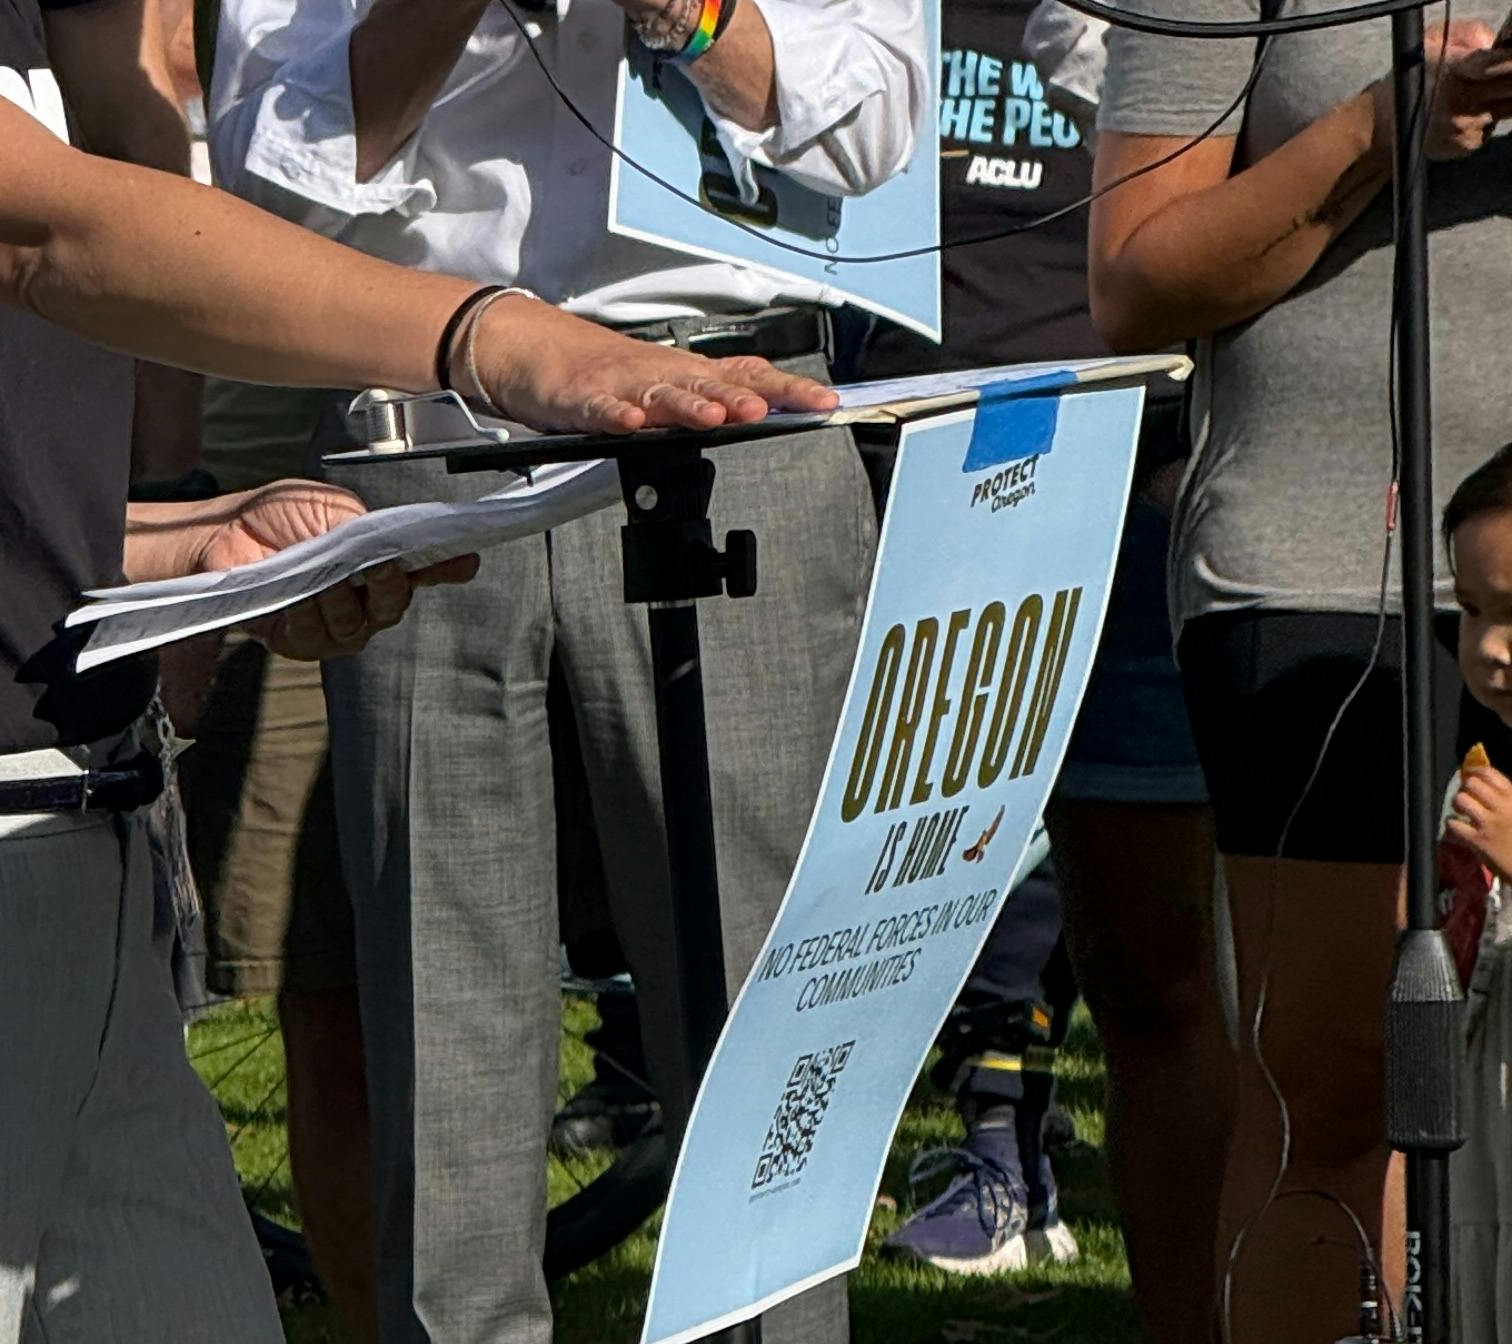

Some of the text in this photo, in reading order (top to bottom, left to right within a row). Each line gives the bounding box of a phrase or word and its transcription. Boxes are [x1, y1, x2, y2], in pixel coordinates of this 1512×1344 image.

[939, 97, 996, 143] HE
[965, 154, 1044, 189] ACLU
[969, 452, 1039, 508] PROTECT
[991, 481, 1036, 514] Oregon
[841, 586, 1084, 824] OREGON
[864, 805, 971, 895] IS HOME
[758, 888, 998, 983] NO FEDERAL FORCES IN OUR
[795, 947, 923, 1013] COMMUNITIES
